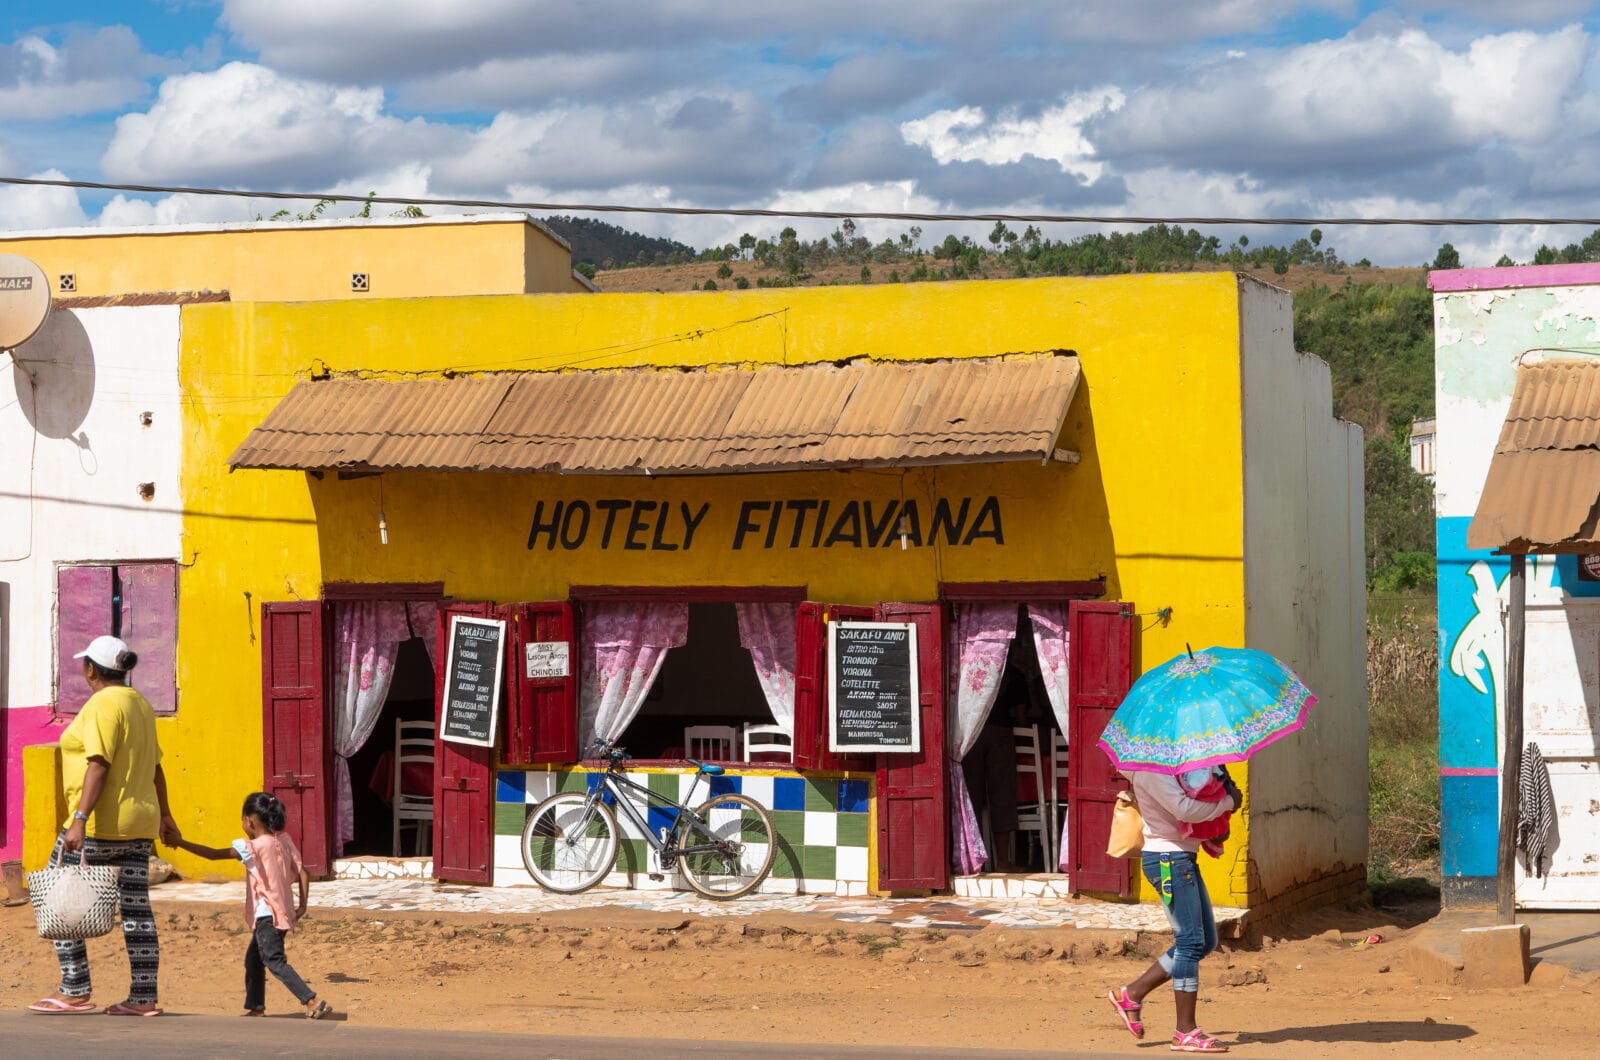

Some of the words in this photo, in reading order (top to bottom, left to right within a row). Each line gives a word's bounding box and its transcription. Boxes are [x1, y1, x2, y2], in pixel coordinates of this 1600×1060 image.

[527, 499, 710, 550] HOTELY
[732, 496, 1005, 549] FITIAVANA
[459, 626, 484, 638] SAKAFO
[840, 630, 882, 640] SAKAFO
[884, 631, 905, 641] ANIO
[846, 645, 868, 653] BITRO
[842, 655, 878, 665] TRONDRO
[531, 668, 564, 677] CHINOISE
[842, 668, 872, 676] VORONA
[841, 679, 881, 689] COTELETTE
[876, 702, 898, 710] SAOSY
